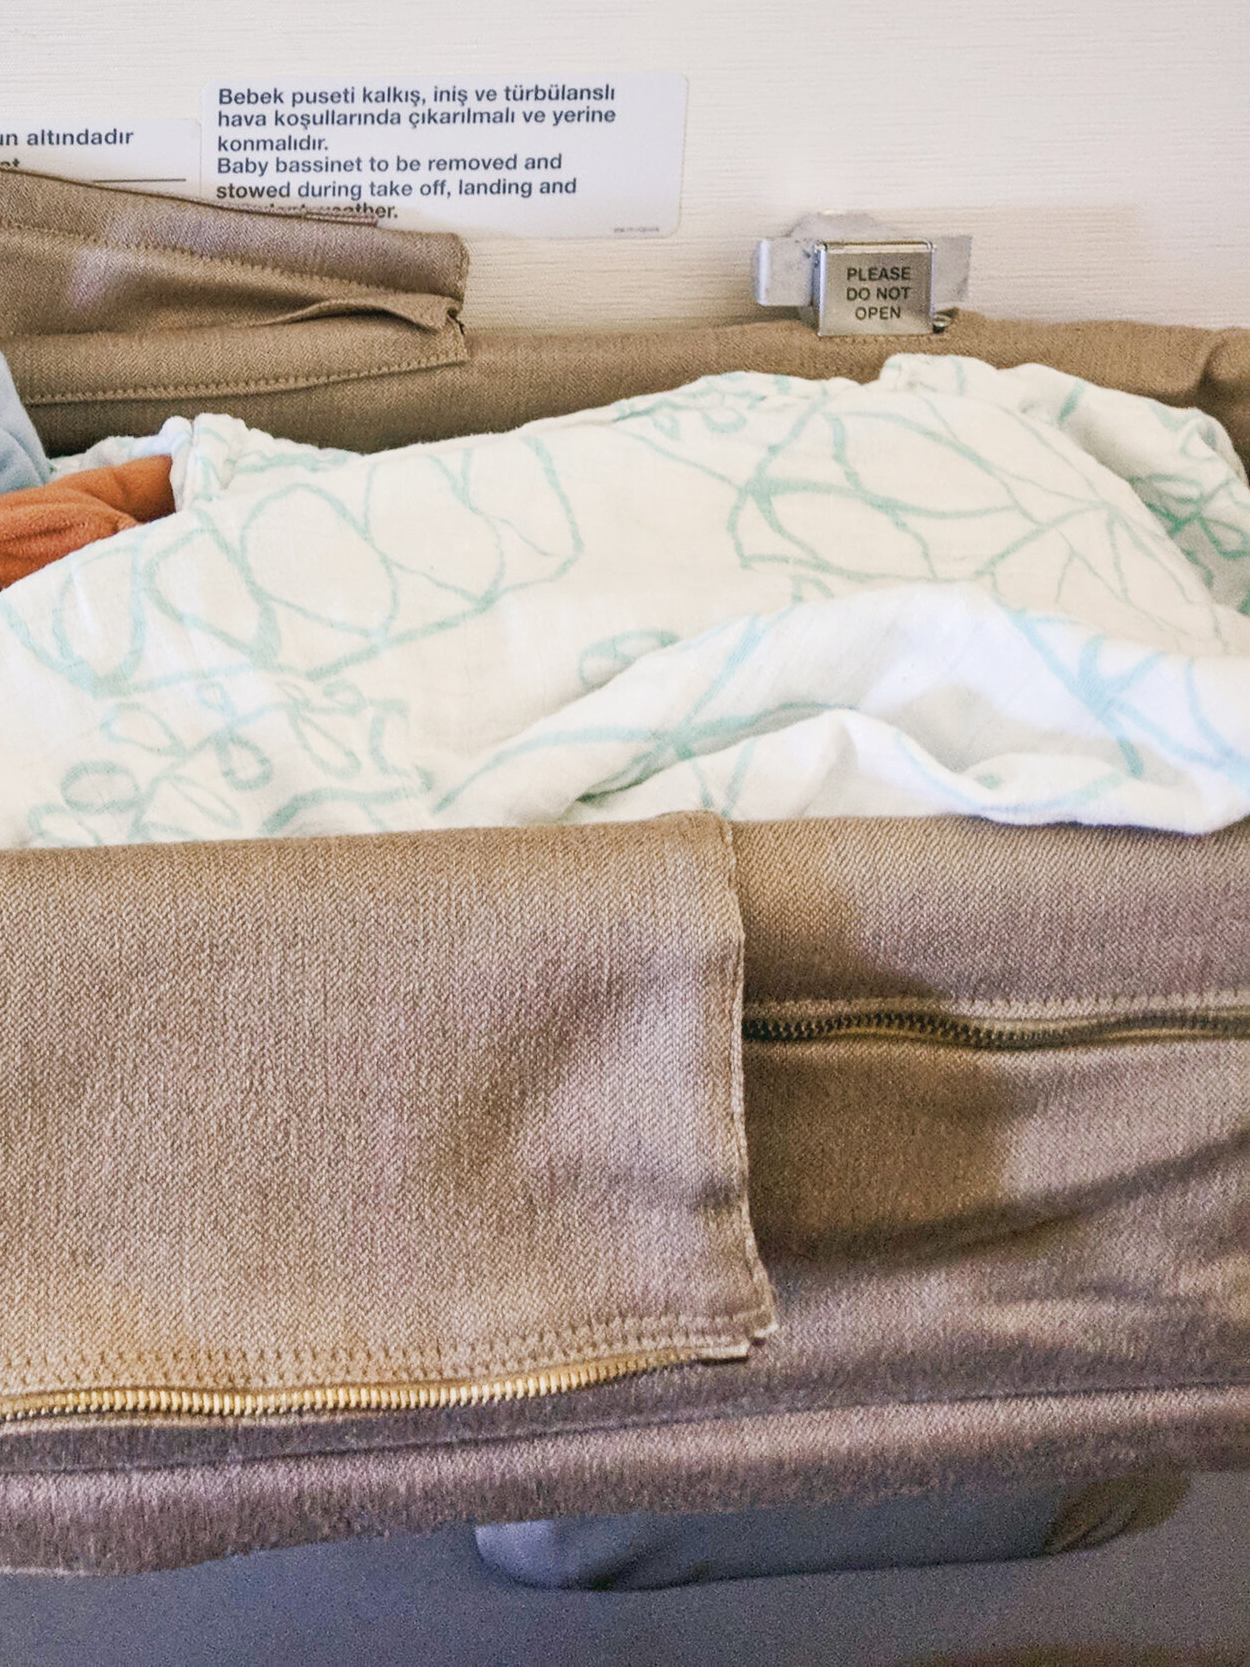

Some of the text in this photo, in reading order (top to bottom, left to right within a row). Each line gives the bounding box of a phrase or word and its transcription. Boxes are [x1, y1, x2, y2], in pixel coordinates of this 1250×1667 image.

[219, 84, 615, 107] Bebek puseti kalkış, iniş ve türbülanslı
[218, 106, 616, 130] hava koşullarında çıkarılmalı ve yerine
[27, 128, 134, 146] altındadır
[218, 135, 329, 152] konmalıdır.
[217, 153, 562, 177] Baby bassinet to be removed and
[216, 178, 577, 200] stowed during take off, landing and
[846, 266, 911, 281] PLEASE
[846, 286, 912, 301] DO NOT
[855, 306, 901, 320] OPEN
